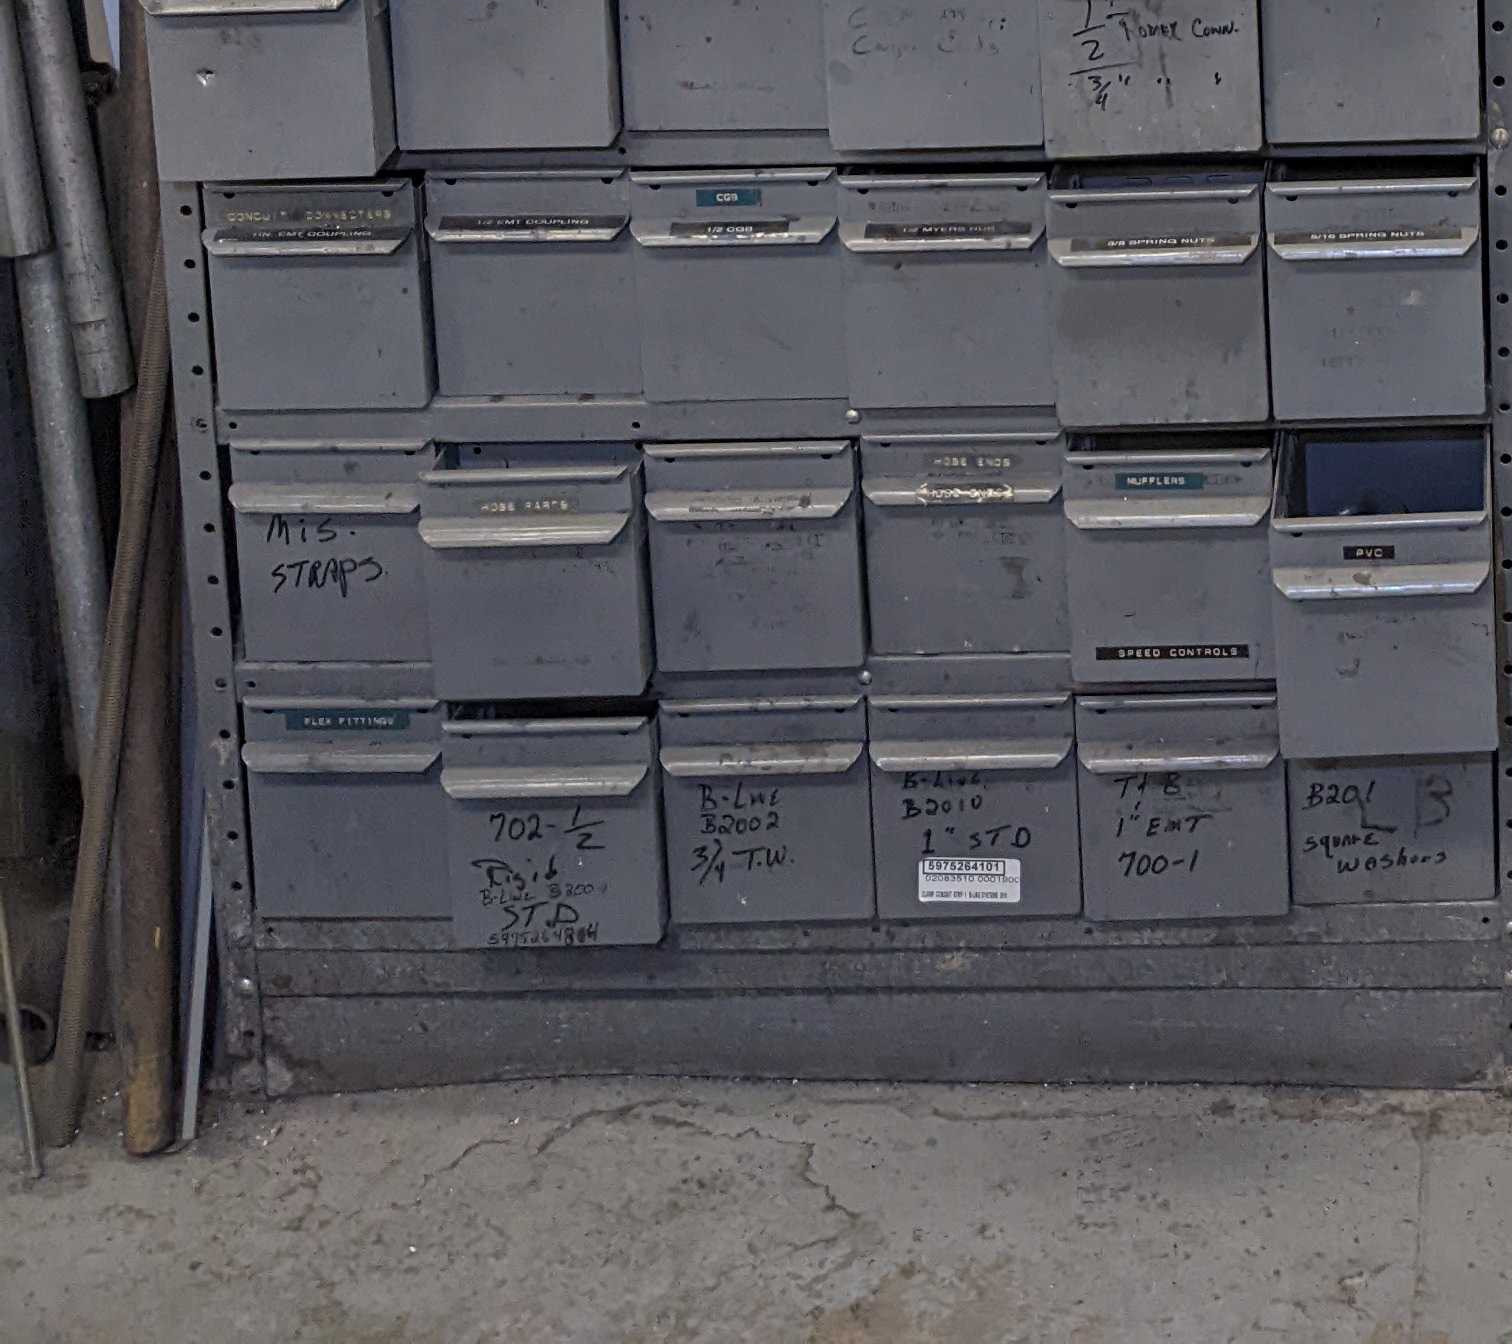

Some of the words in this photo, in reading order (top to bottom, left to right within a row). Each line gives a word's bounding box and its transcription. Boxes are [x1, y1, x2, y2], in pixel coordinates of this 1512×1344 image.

[1338, 230, 1387, 240] SPRING
[1389, 229, 1425, 240] NUTS
[1355, 547, 1383, 559] PVC
[1117, 647, 1161, 660] SPEED
[1168, 645, 1240, 659] CONTROLS
[927, 860, 1000, 873] 5975264101
[1118, 850, 1198, 878] 700-1
